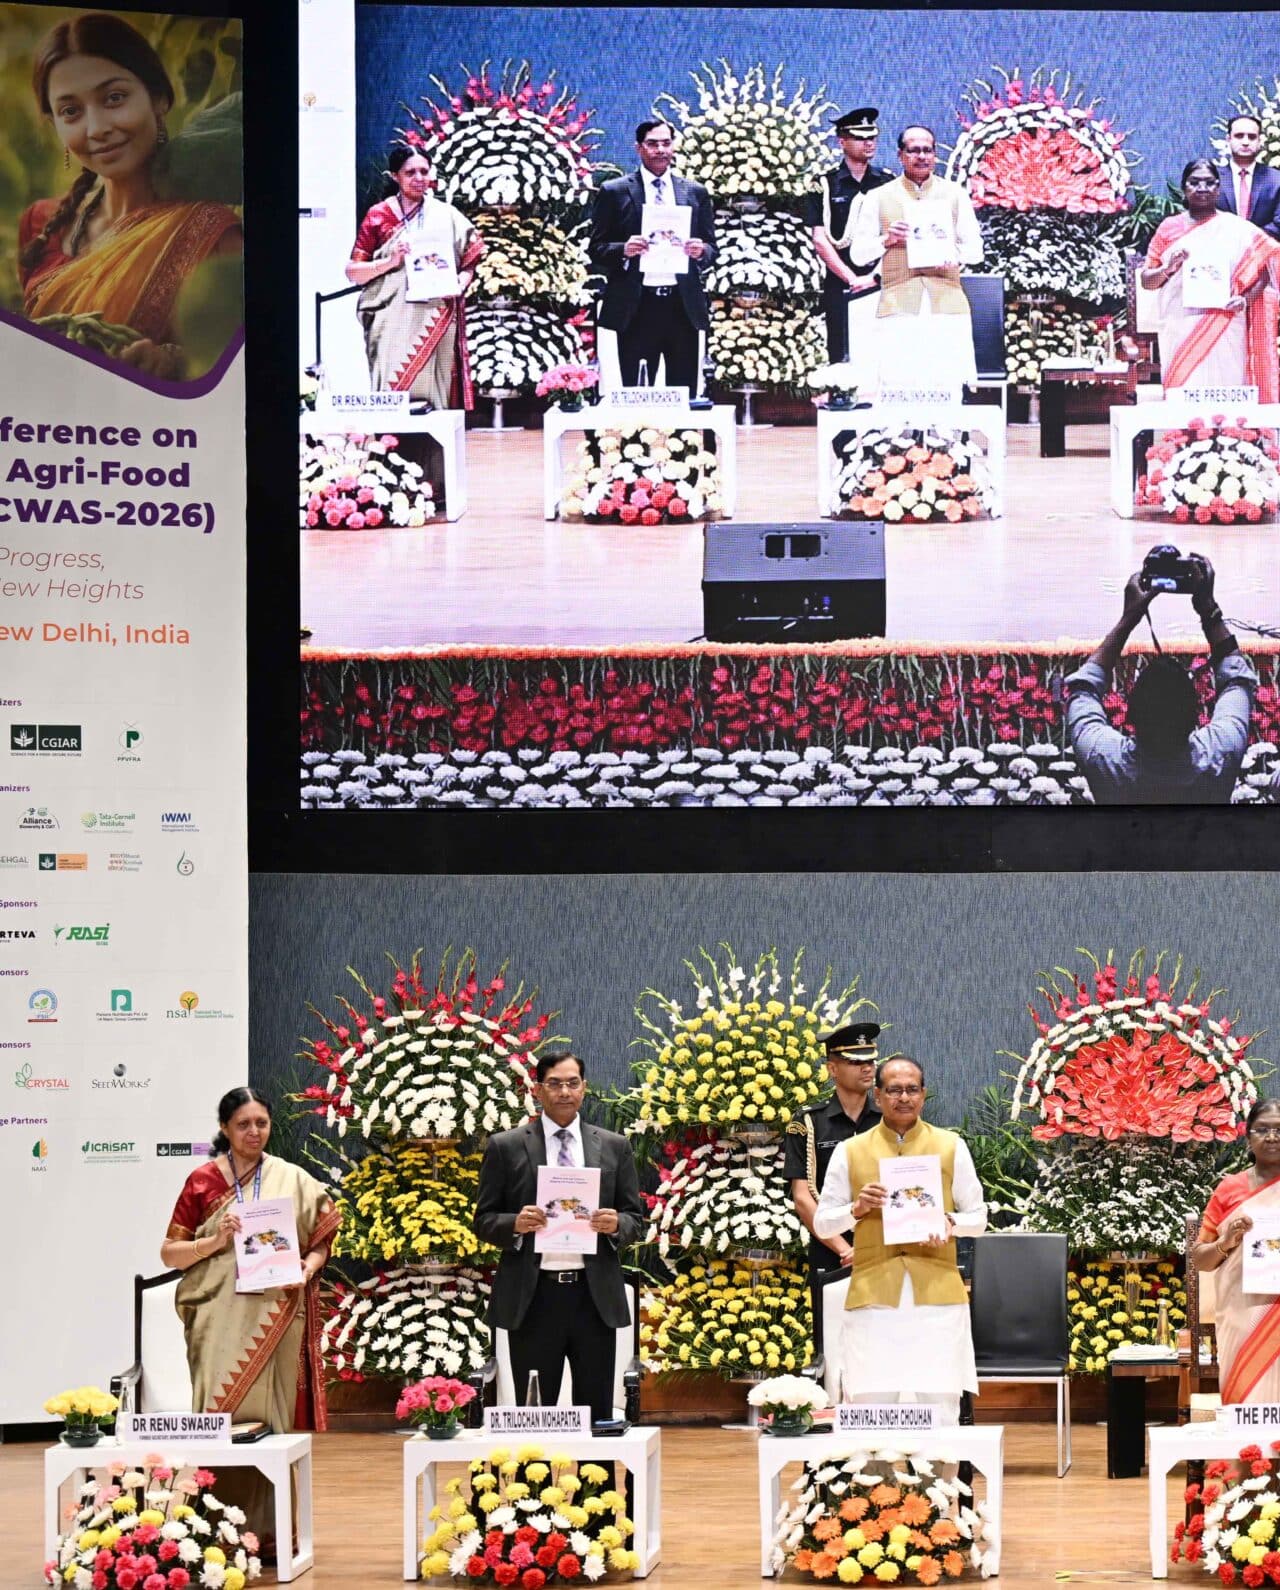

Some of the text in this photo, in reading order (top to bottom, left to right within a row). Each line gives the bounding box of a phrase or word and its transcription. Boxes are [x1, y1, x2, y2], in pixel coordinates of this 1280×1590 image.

[332, 395, 403, 406] DR RENU SWARUP
[1184, 389, 1254, 402] THE PRESIDENT
[152, 426, 198, 448] on
[6, 456, 190, 490] Agri-Food
[0, 579, 144, 603] ew Heights
[43, 623, 117, 646] Delhi,
[126, 624, 190, 644] India
[42, 738, 78, 748] CGIAR
[27, 1079, 70, 1088] CRYSTAL
[491, 1411, 581, 1428] DR. TRILOCHAN MOHAPATRA
[840, 1409, 932, 1425] SH SHIVRAJ SINGH CHOUHAN
[1235, 1407, 1259, 1424] THE
[133, 1417, 224, 1431] DR RENU SWARUP
